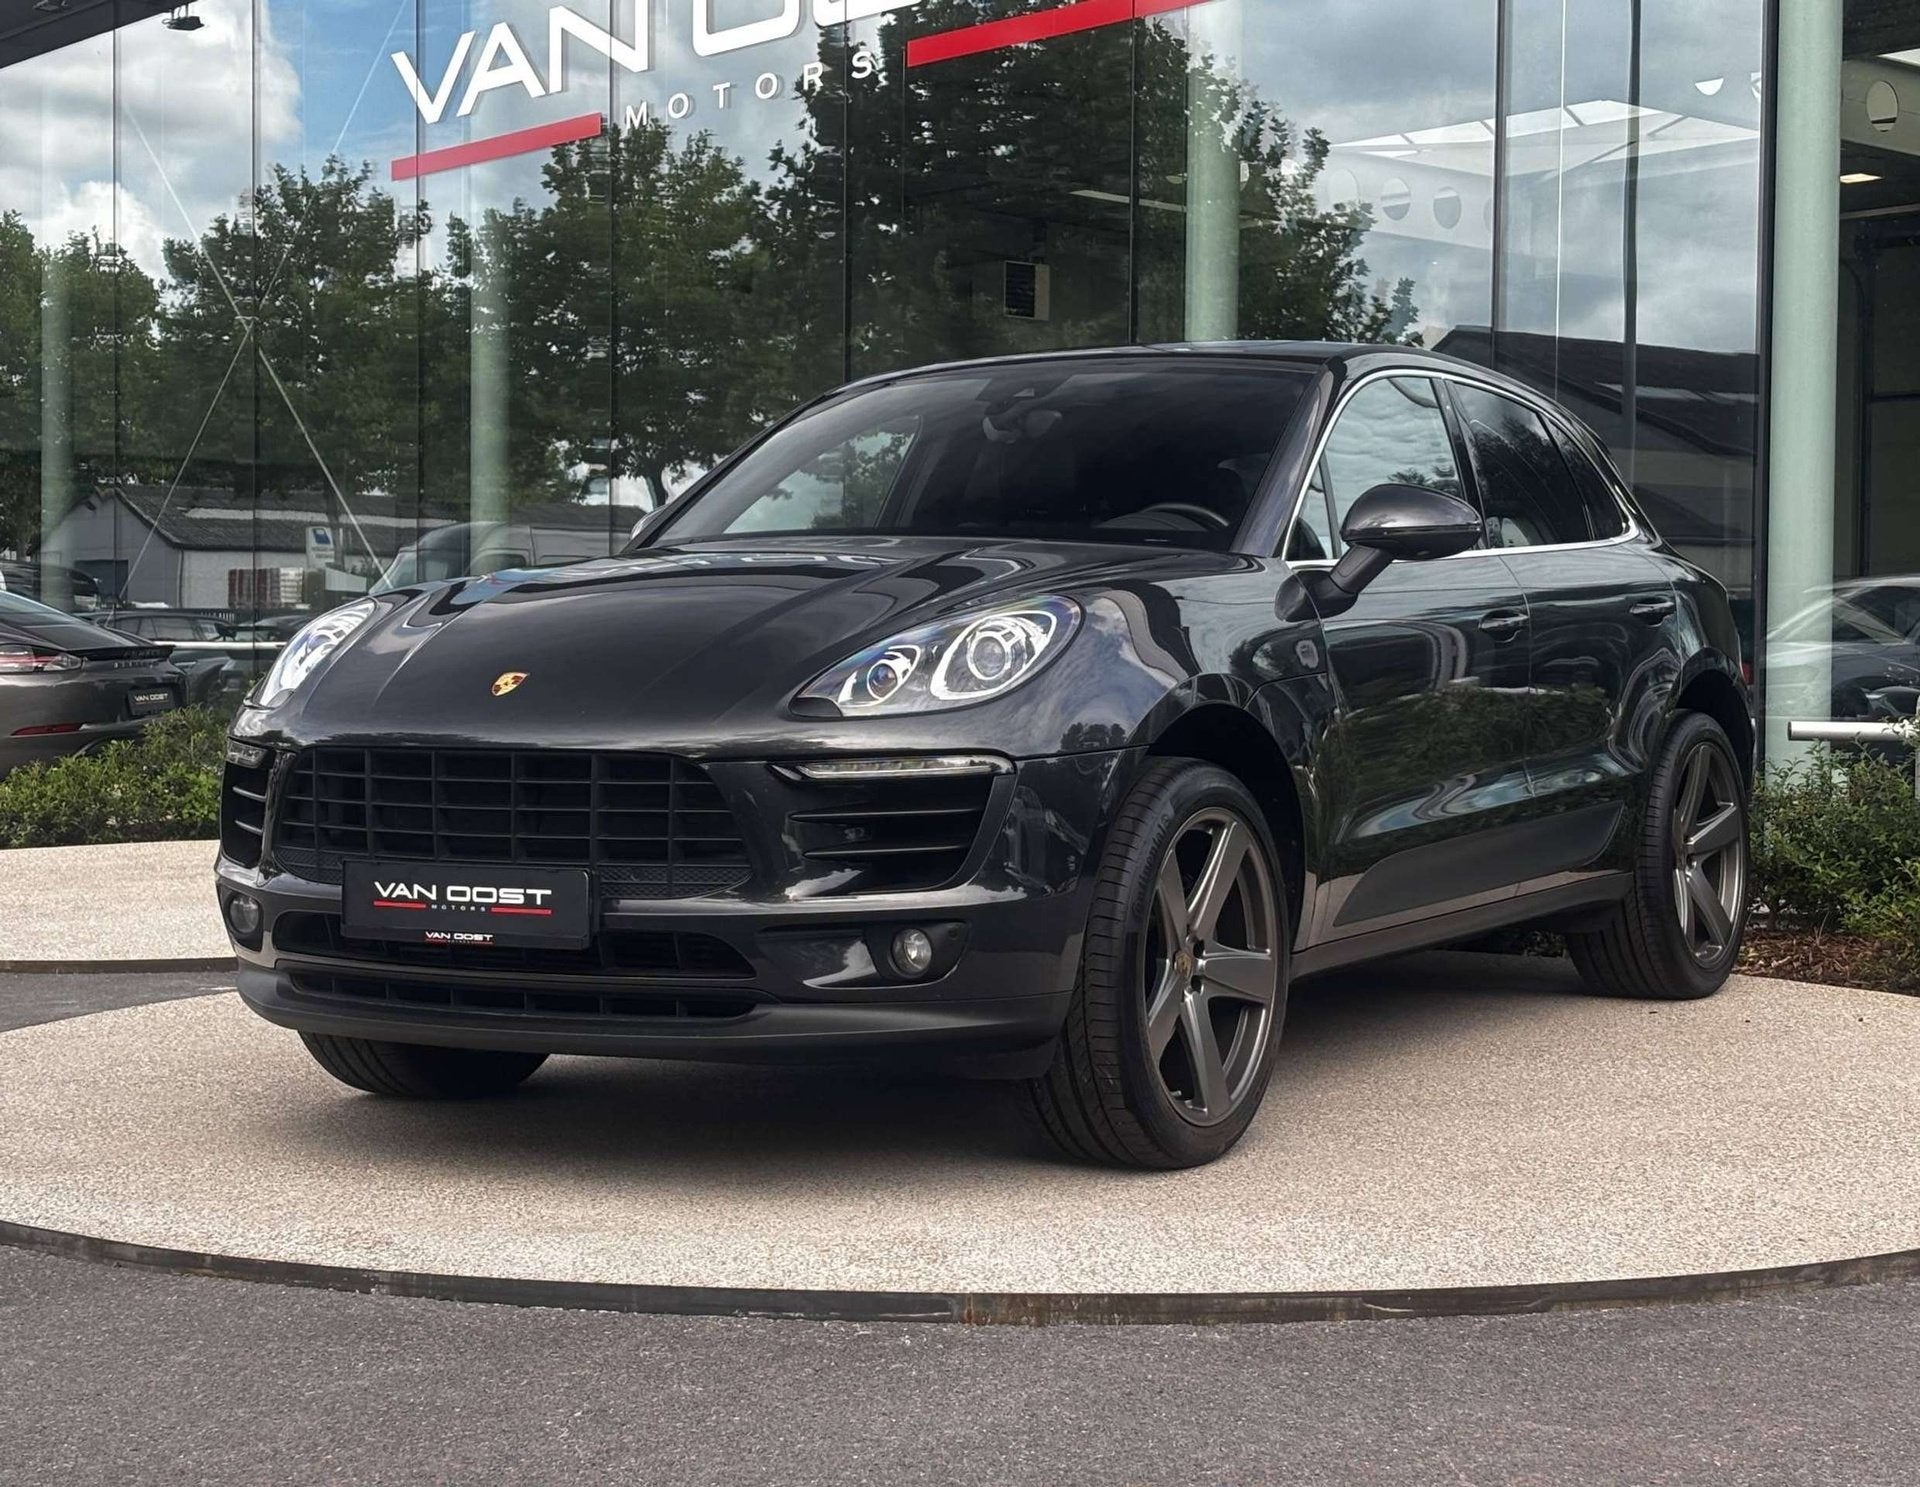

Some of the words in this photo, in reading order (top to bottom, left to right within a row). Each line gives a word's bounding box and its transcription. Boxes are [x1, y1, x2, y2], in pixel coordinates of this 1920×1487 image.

[390, 0, 649, 124] VAN
[625, 51, 874, 130] MOTORS
[374, 881, 437, 900] VAN
[446, 885, 552, 905] OOST
[431, 904, 486, 912] MOTORS
[425, 931, 451, 939] VAN
[453, 933, 494, 941] OOST
